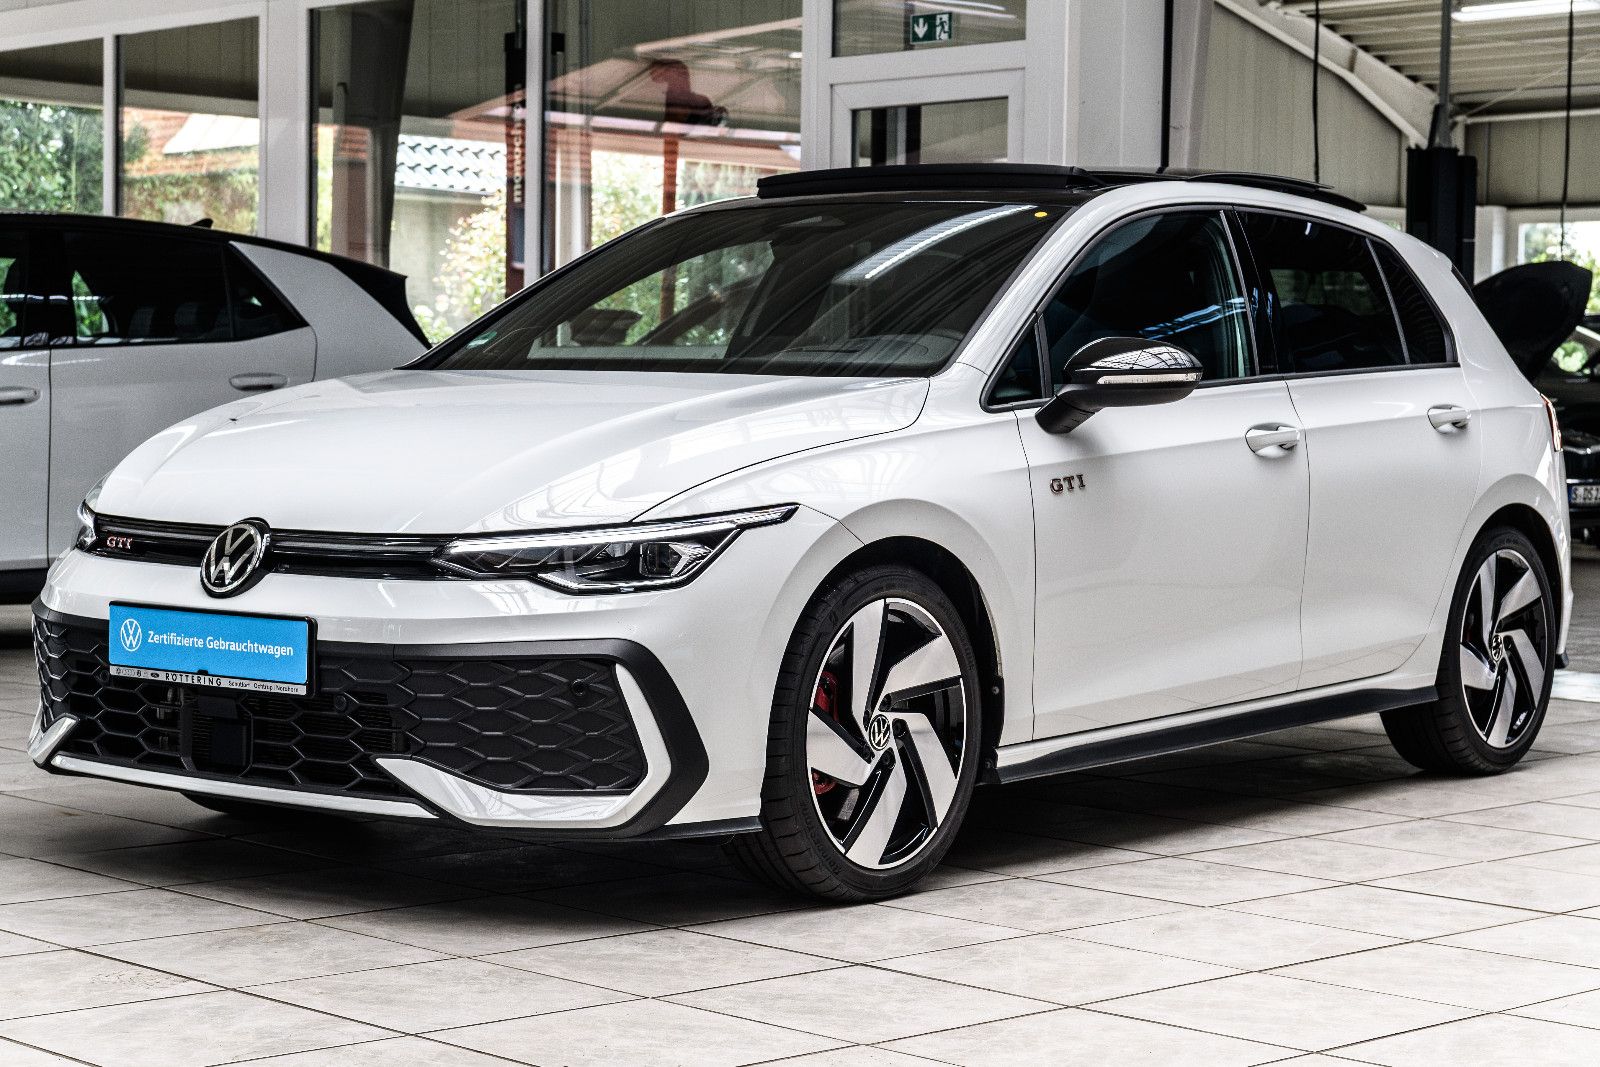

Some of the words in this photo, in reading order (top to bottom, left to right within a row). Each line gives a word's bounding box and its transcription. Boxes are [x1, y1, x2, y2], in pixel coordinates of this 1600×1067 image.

[1050, 474, 1085, 494] GTI
[106, 536, 132, 549] GTI
[148, 631, 204, 648] Zertifizierte
[206, 636, 293, 658] Gebrauchtwagen
